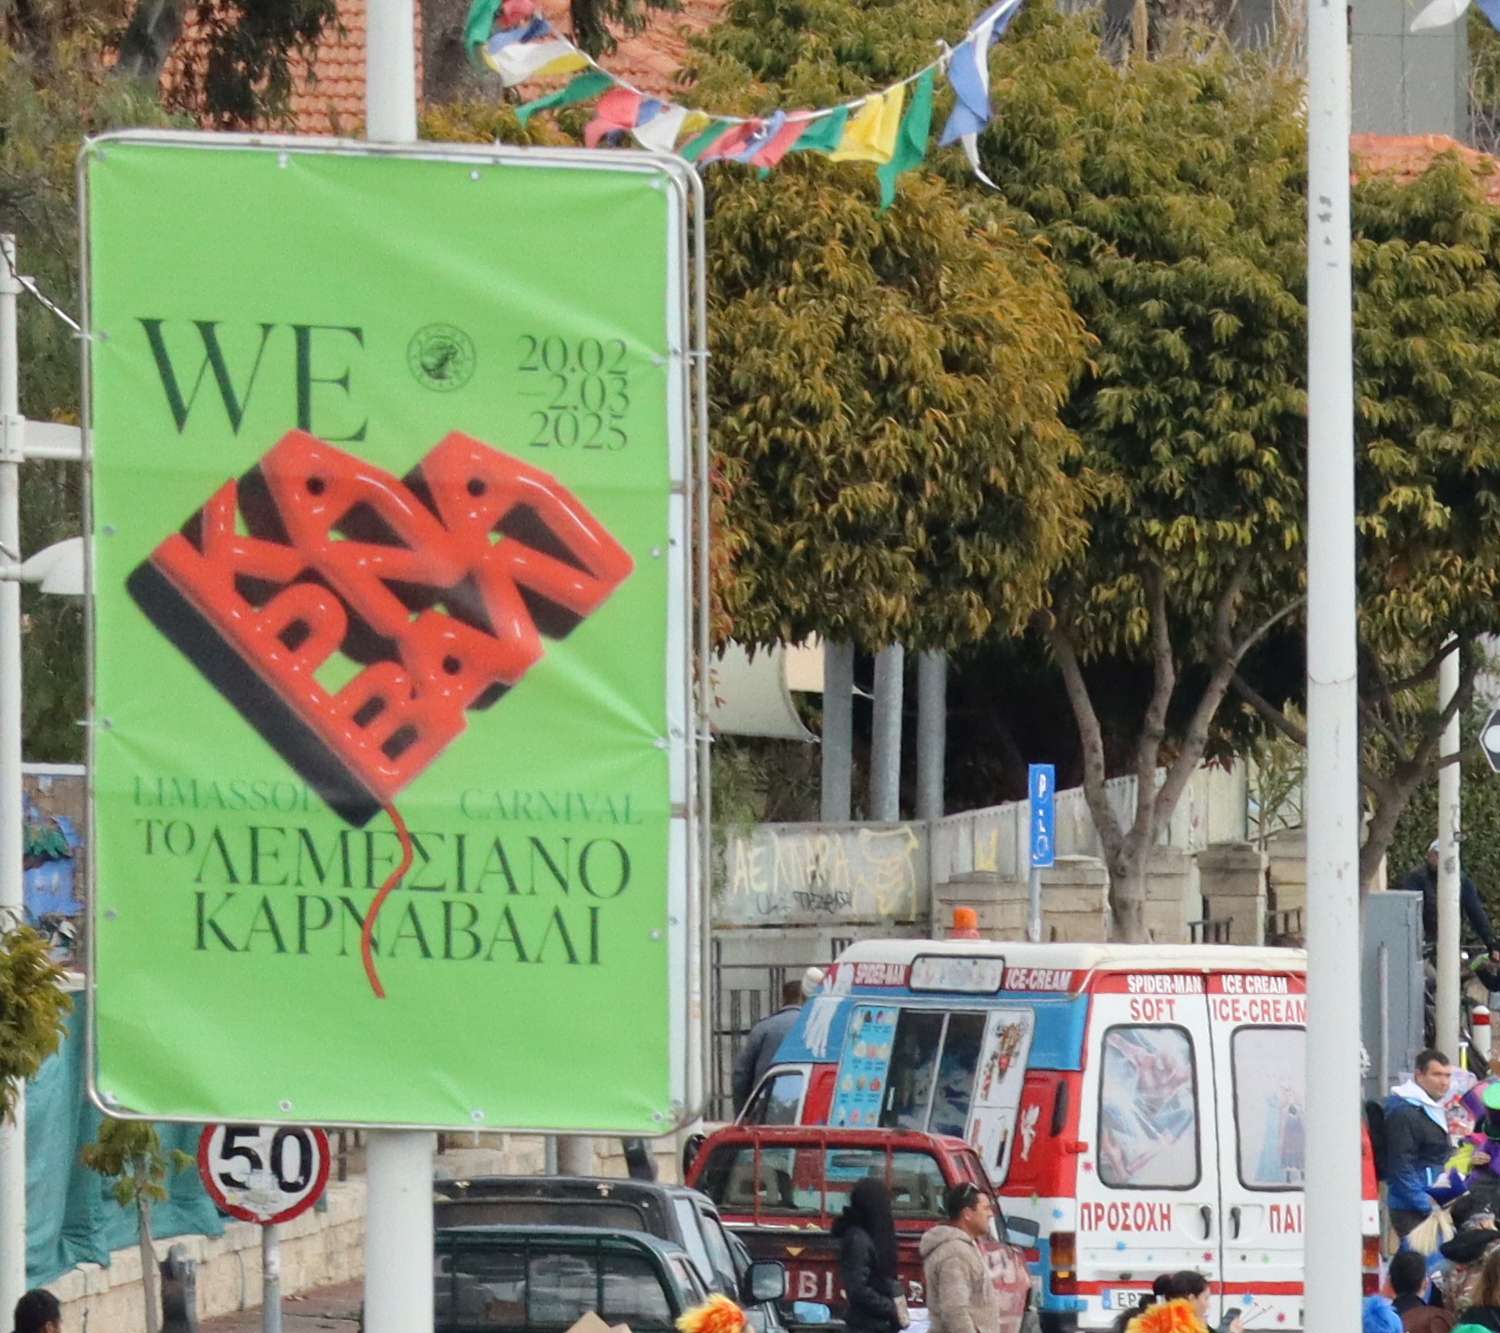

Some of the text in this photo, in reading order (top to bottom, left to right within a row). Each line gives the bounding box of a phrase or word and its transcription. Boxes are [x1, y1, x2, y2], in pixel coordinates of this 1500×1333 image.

[516, 334, 629, 375] 20.02
[136, 317, 368, 443] WE
[529, 411, 628, 450] 2025
[460, 787, 643, 825] CARNIVAL
[194, 823, 632, 899] ΛΕΜΕΣΙΑΝΟ
[193, 890, 604, 966] ΚΑΡΝΑΒΑΛΙ
[1005, 968, 1073, 992] ICE-CREAM
[1127, 974, 1203, 994] SPIDER-MAN
[1222, 975, 1289, 994] ICE CREAM
[1130, 998, 1176, 1022] SOFT
[218, 1124, 313, 1193] 50
[1080, 1202, 1172, 1233] ΠΡΟΣΟΧΗ
